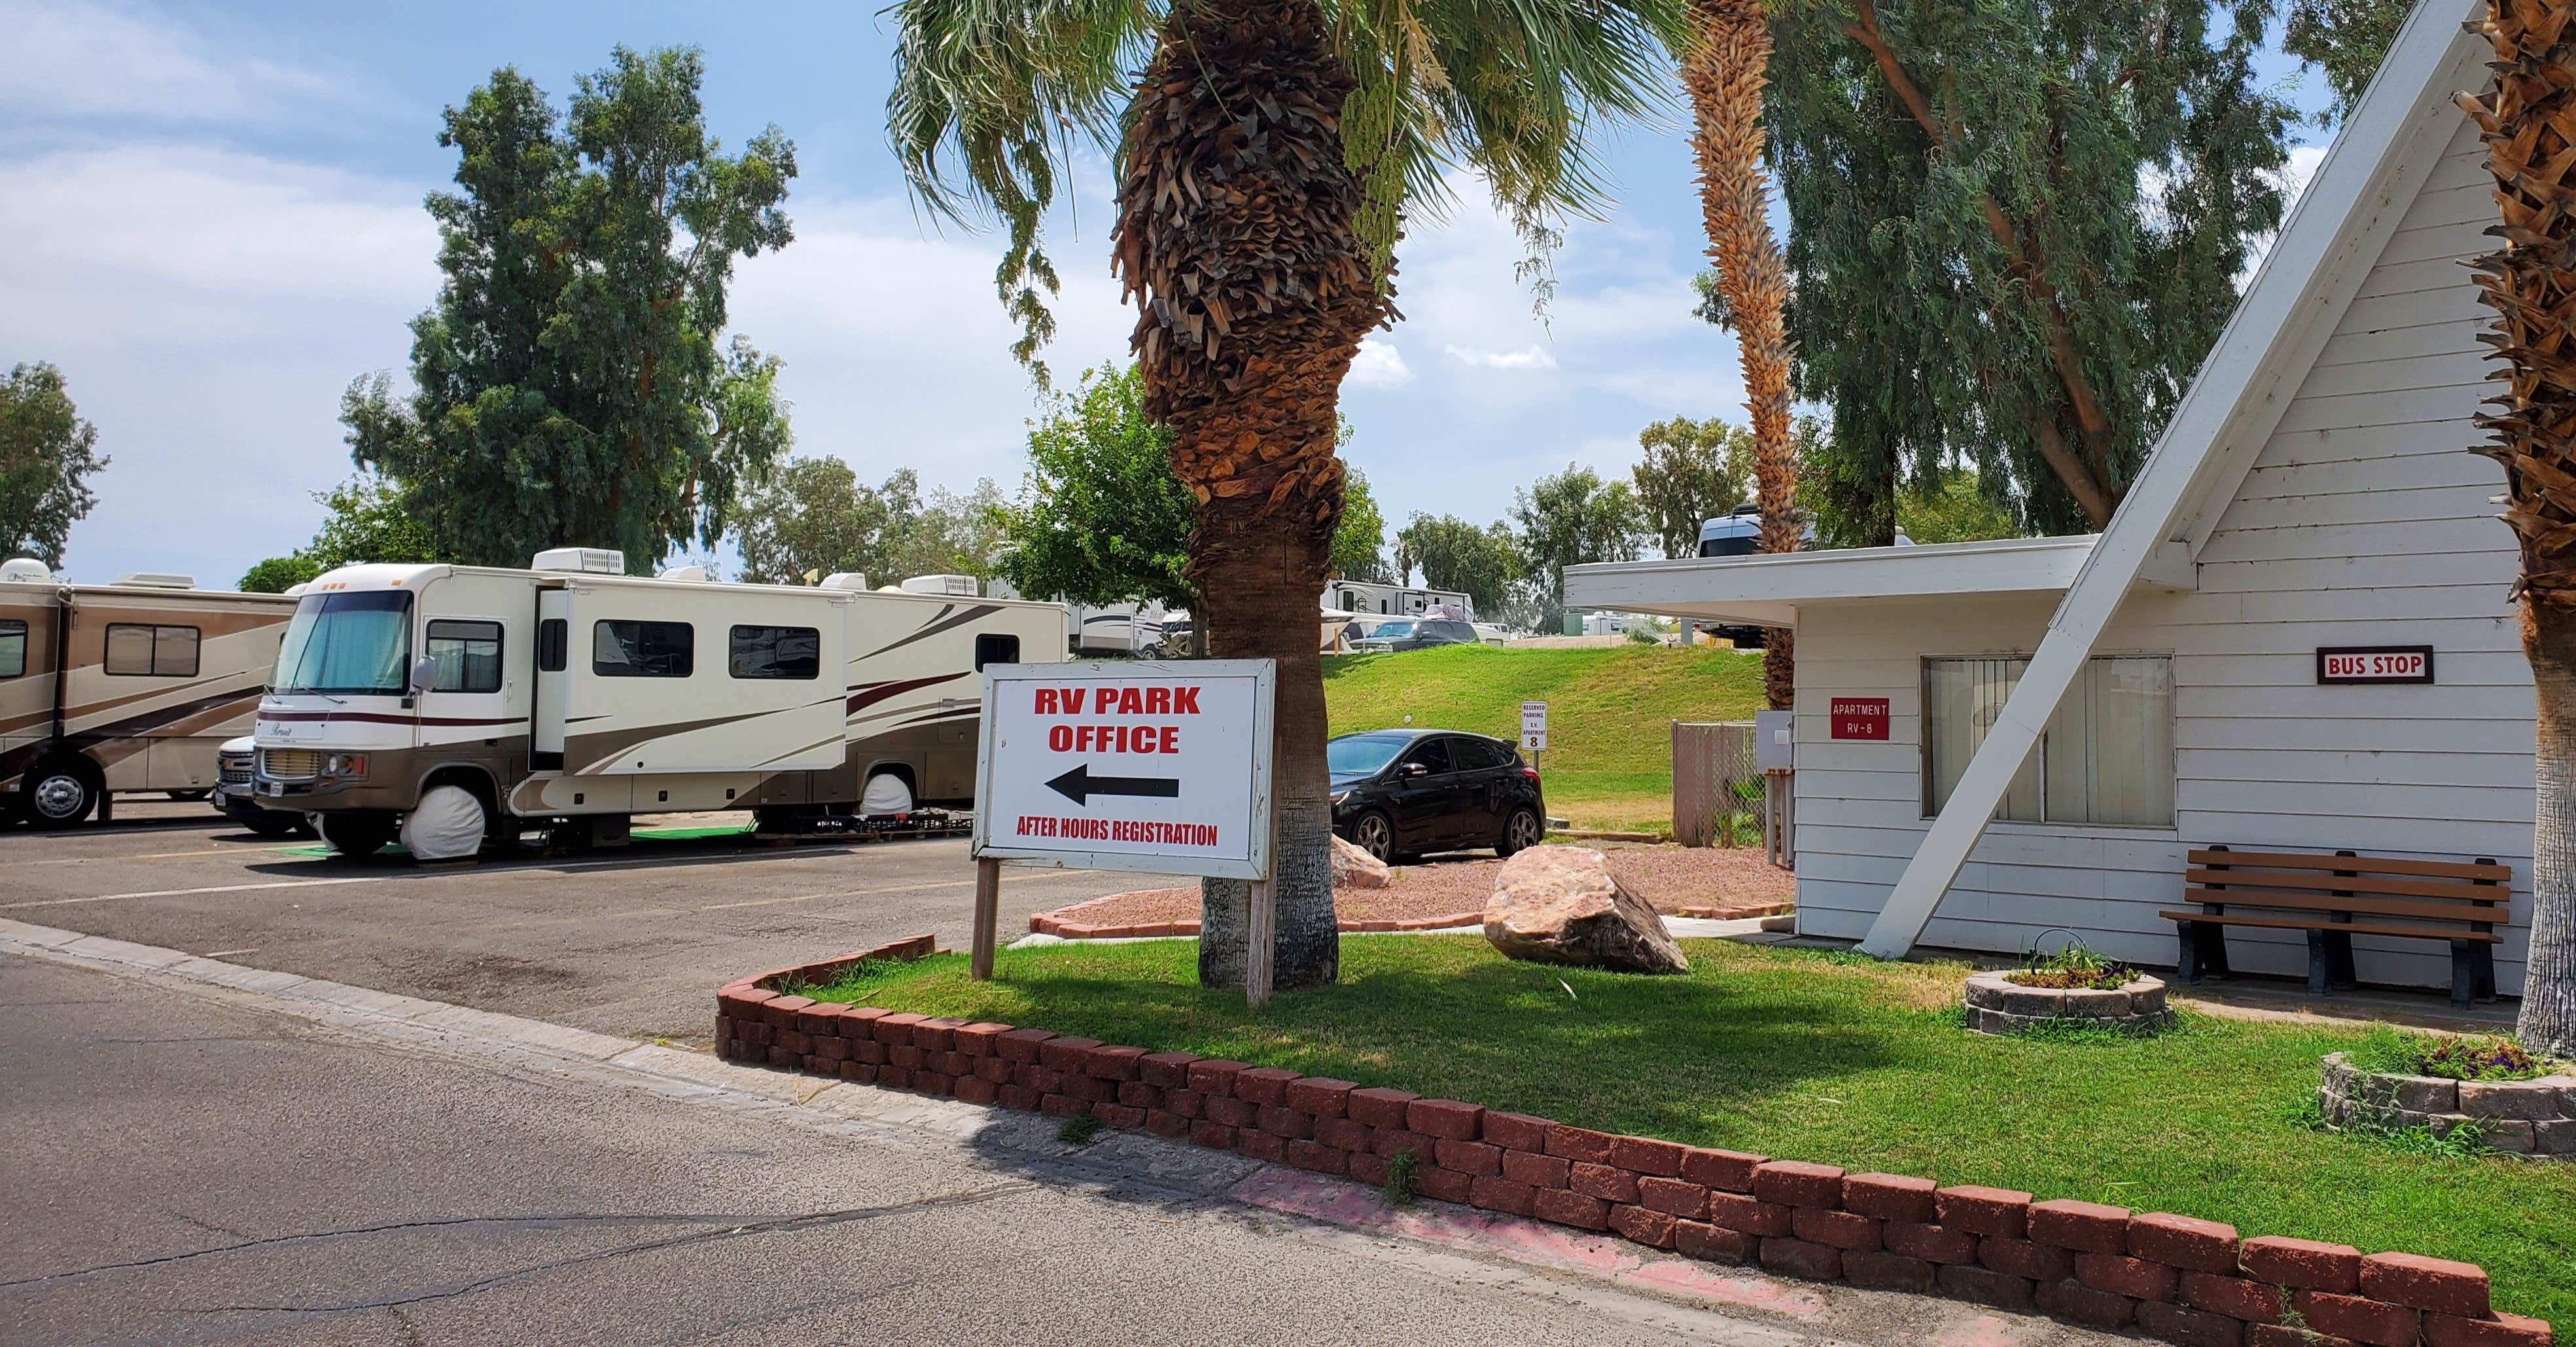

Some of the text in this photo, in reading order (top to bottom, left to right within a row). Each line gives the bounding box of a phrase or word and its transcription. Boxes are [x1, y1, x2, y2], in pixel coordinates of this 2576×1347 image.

[2329, 656, 2422, 675] BUS STOP
[1034, 687, 1201, 715] RV PARK
[1833, 704, 1887, 715] APARTMENT
[1049, 725, 1180, 754] OFFICE
[1530, 737, 1538, 747] 8
[1017, 816, 1218, 846] AFTER HOURS REGISTRATION
